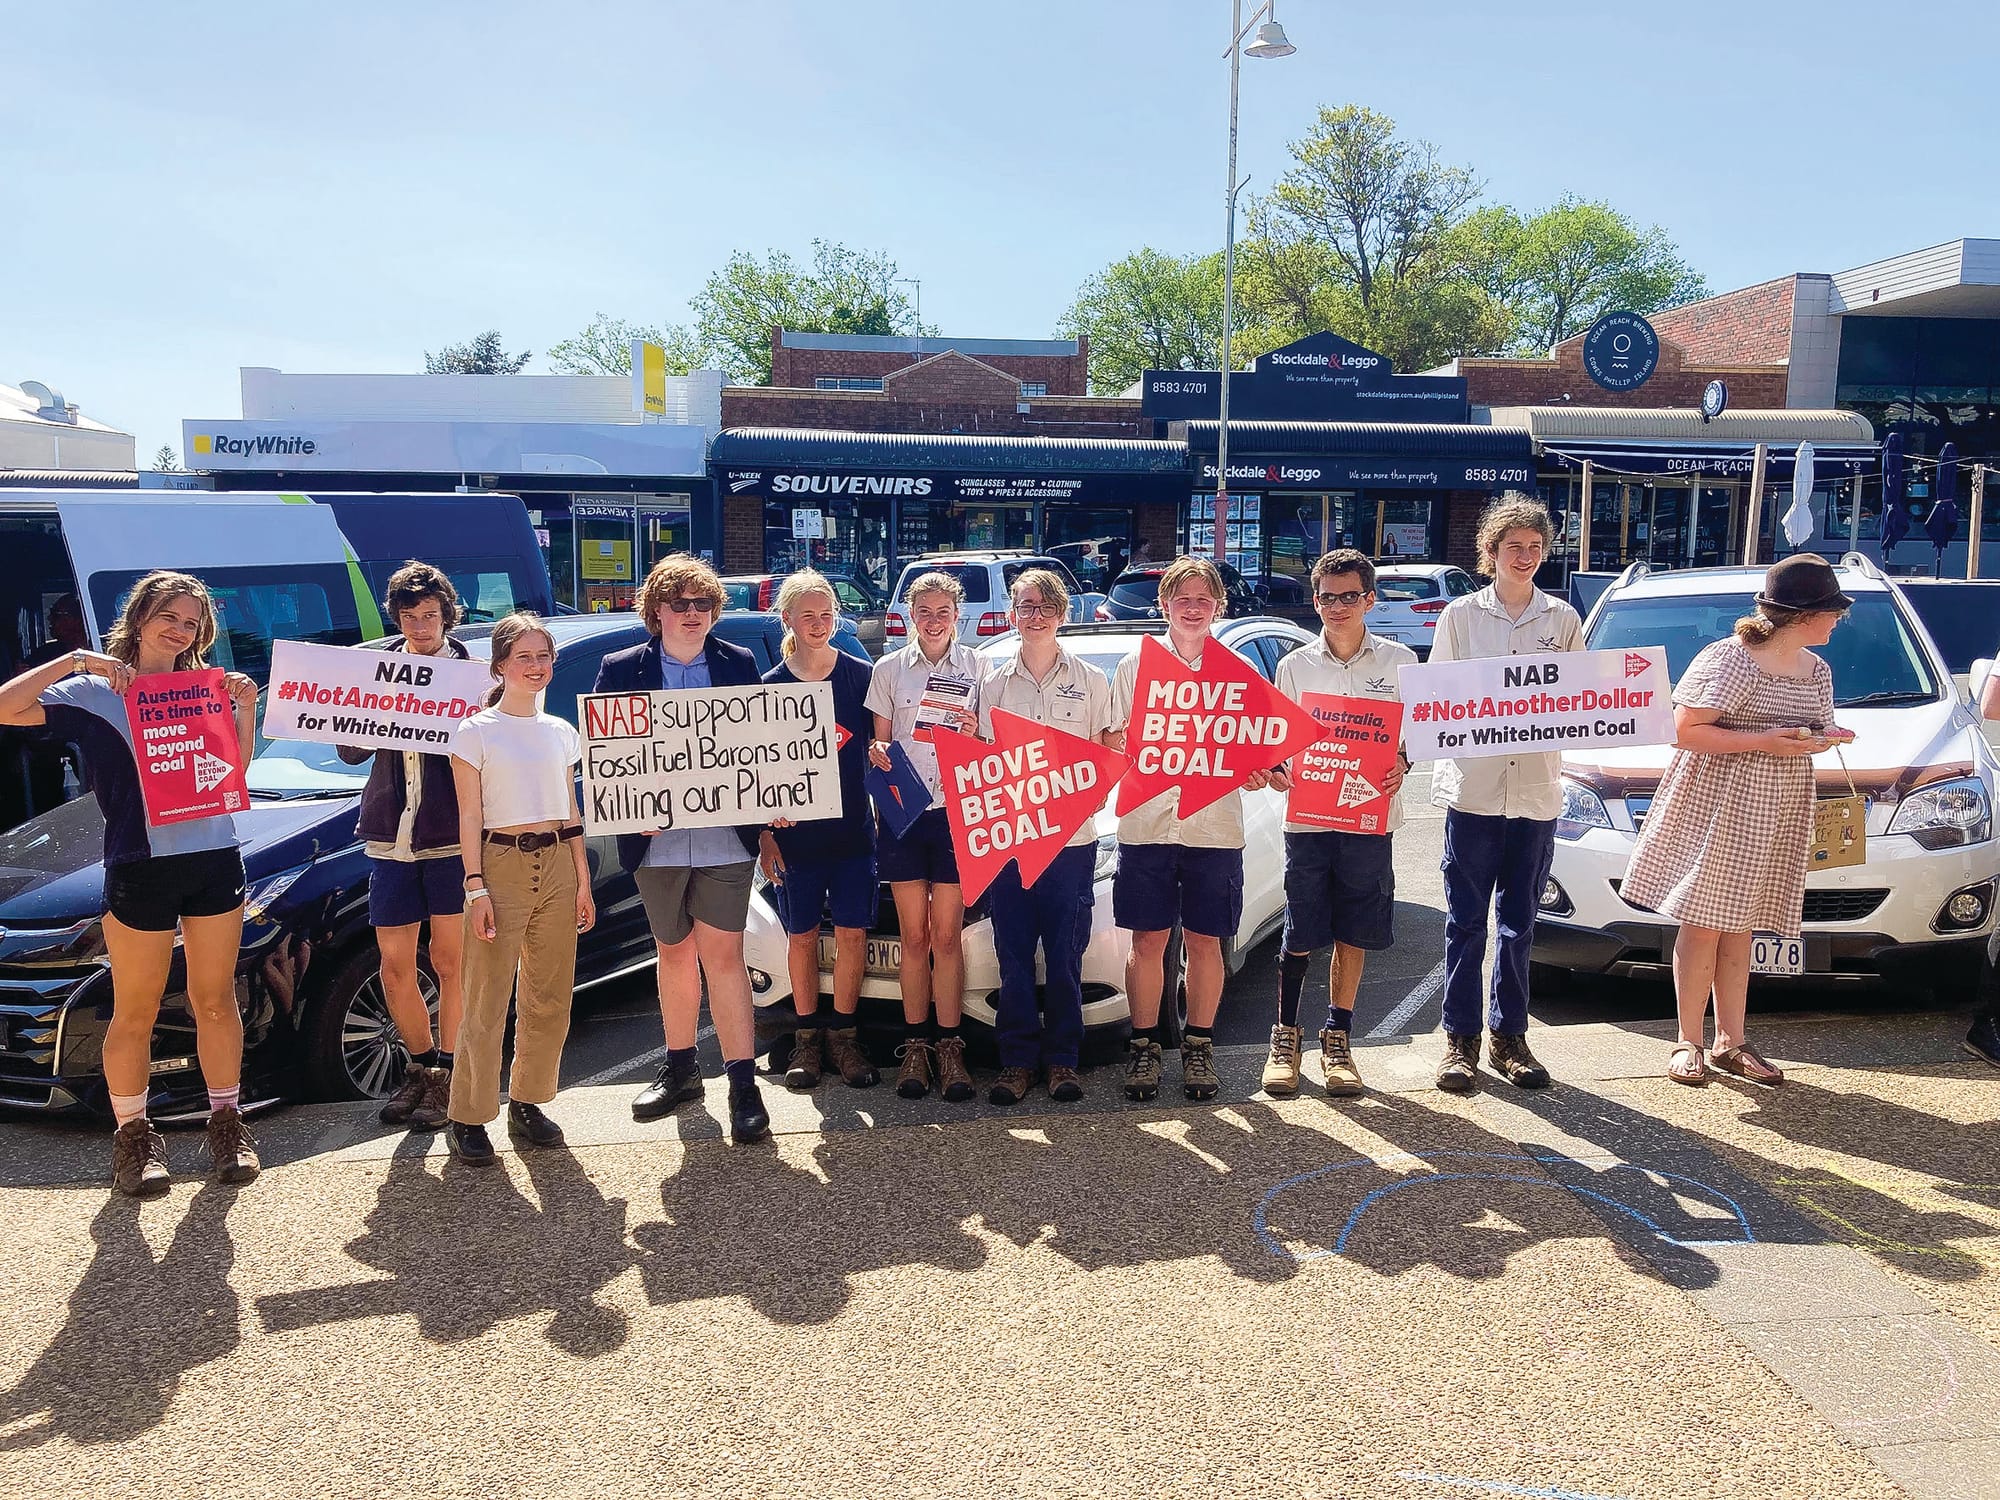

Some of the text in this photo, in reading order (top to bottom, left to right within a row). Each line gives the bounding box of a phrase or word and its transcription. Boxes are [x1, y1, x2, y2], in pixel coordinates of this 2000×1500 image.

[1591, 317, 1653, 345] OCEAN REACH BREWING
[1286, 374, 1295, 382] We
[1320, 374, 1334, 383] than
[1334, 375, 1359, 386] property
[1589, 357, 1652, 386] COWES PHILLIP ISLAND
[1152, 381, 1208, 394] 8583 4701
[214, 435, 316, 457] RayWhite
[728, 471, 762, 480] U-NEEK
[1465, 468, 1528, 482] 8583 4701
[1667, 459, 1753, 472] OCEAN REACH
[771, 474, 933, 496] SOUVENIRS
[960, 478, 1082, 488] SUNGLASSES HATS CLOTHING
[1349, 471, 1360, 480] We
[1373, 472, 1389, 480] more
[1390, 469, 1407, 480] than
[1408, 472, 1438, 484] property
[966, 488, 984, 496] TOYS
[995, 488, 1016, 497] PIPES
[1024, 489, 1072, 497] ACCESSORIES
[374, 661, 434, 687] NAB
[1503, 663, 1560, 688] NAB
[137, 684, 214, 706] Australia,
[1146, 680, 1248, 711] MOVE
[1411, 687, 1654, 722] #NotAnotherDollar
[167, 703, 203, 719] time
[206, 702, 222, 714] to
[1311, 706, 1386, 729] Australia,
[143, 723, 187, 740] move
[297, 712, 450, 744] for Whitehaven
[1141, 713, 1288, 746] BEYOND
[1334, 725, 1390, 744] time to
[1437, 718, 1636, 748] for Whitehaven Coal
[146, 736, 205, 758] beyond
[588, 725, 829, 779] Fossil Fuel Barons and
[150, 755, 185, 774] coal
[197, 760, 217, 769] MOVE
[198, 766, 227, 776] BEYOND
[953, 739, 1049, 795] MOVE
[1137, 746, 1235, 778] COAL
[1302, 752, 1361, 772] beyond
[198, 774, 218, 783] COAL
[1301, 770, 1336, 784] coal
[1345, 781, 1366, 789] MOVE
[592, 767, 819, 830] Killing our Planet
[960, 760, 1097, 827] BEYOND
[1342, 794, 1362, 802] COAL
[1343, 787, 1374, 796] BEYOND
[159, 801, 220, 817] movebeyondcoal.com
[1295, 811, 1356, 824] movebeyondcoal.com
[967, 808, 1062, 858] COAL
[1755, 941, 1800, 966] 078
